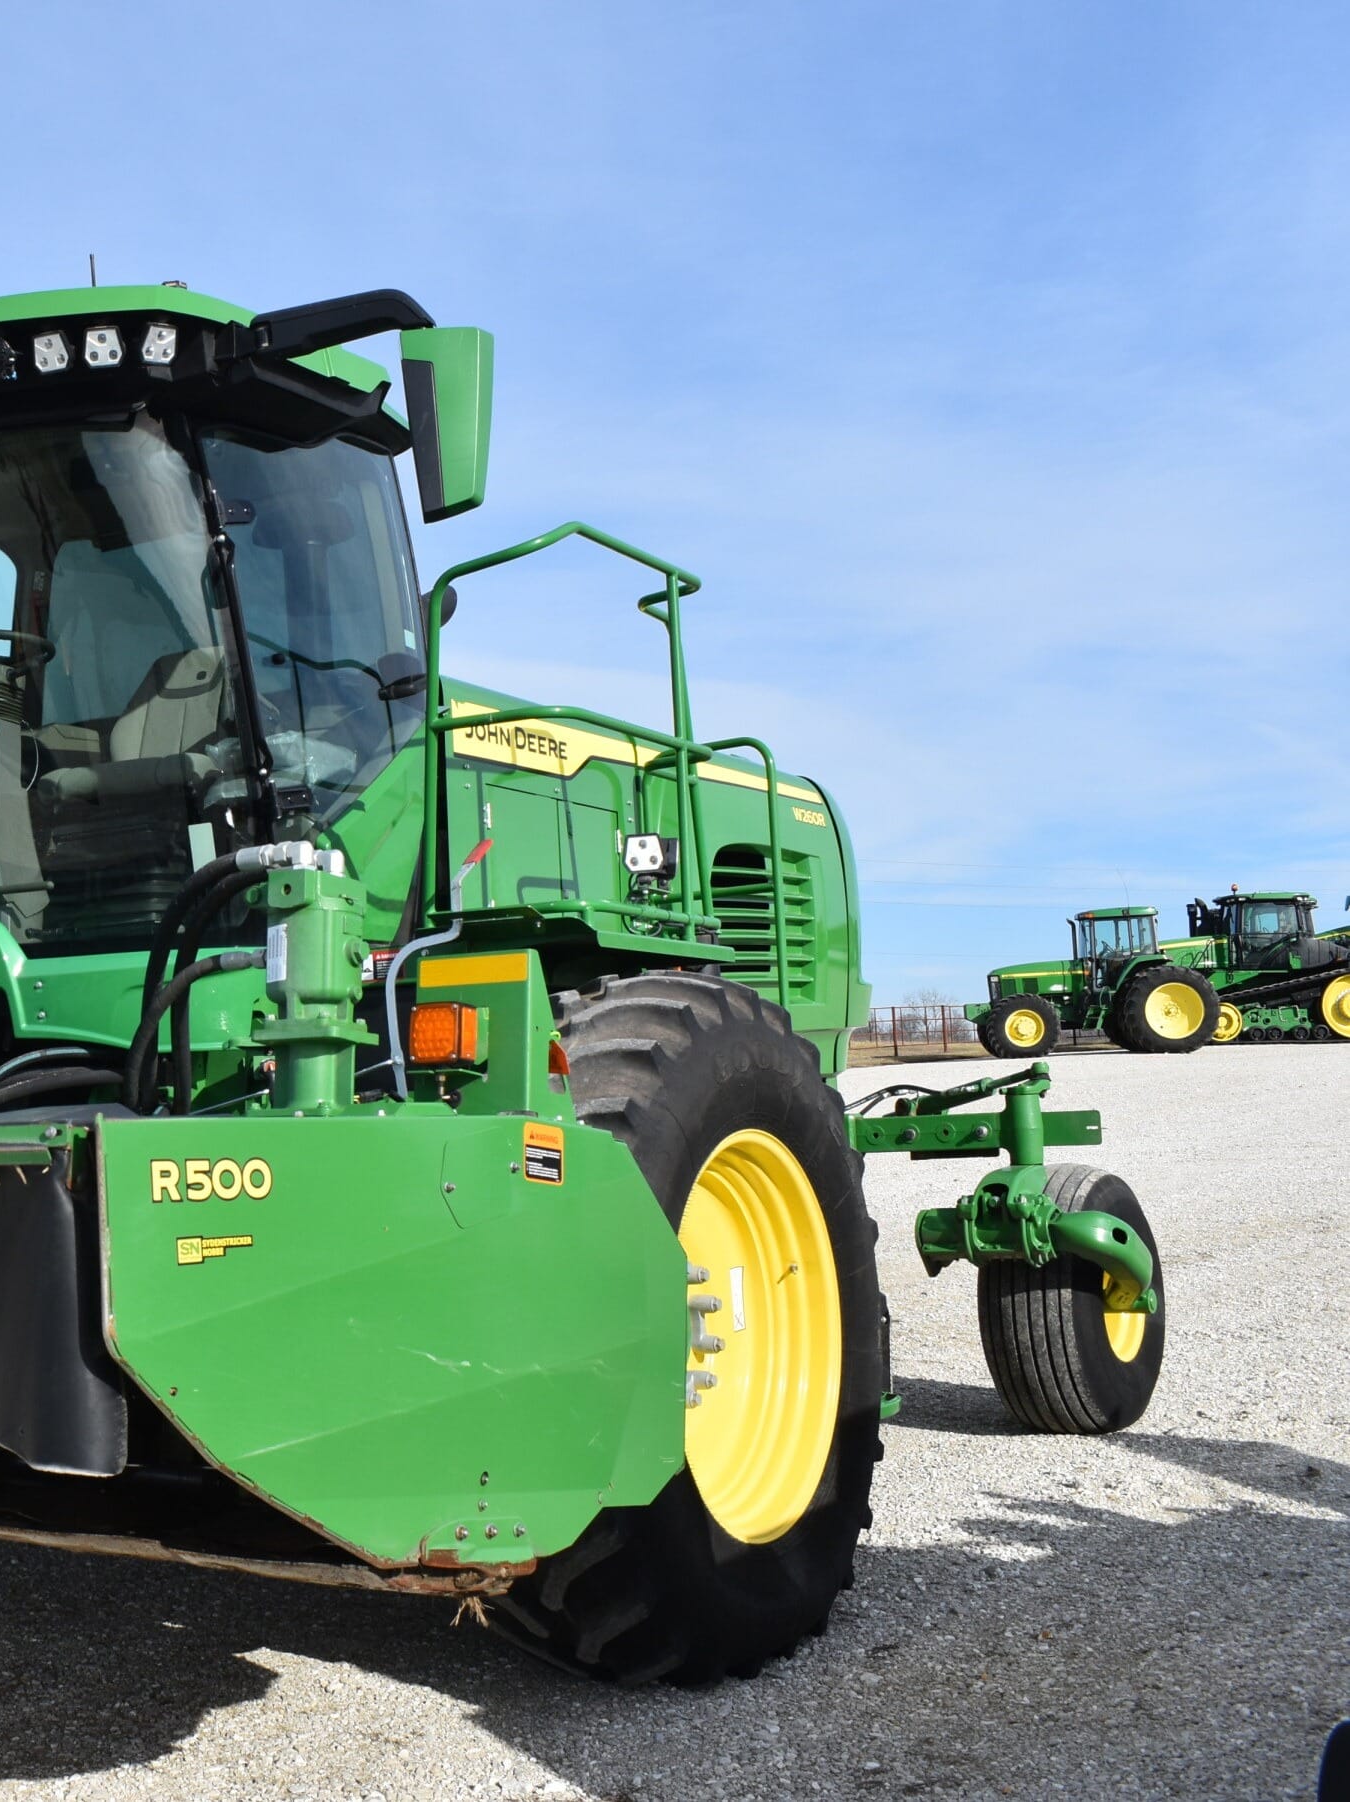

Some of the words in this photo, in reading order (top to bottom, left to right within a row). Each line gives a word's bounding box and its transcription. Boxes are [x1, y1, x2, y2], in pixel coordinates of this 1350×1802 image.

[465, 724, 511, 747] JOHN
[514, 726, 568, 760] DEERE
[792, 806, 827, 828] W260R
[150, 1157, 273, 1203] R500
